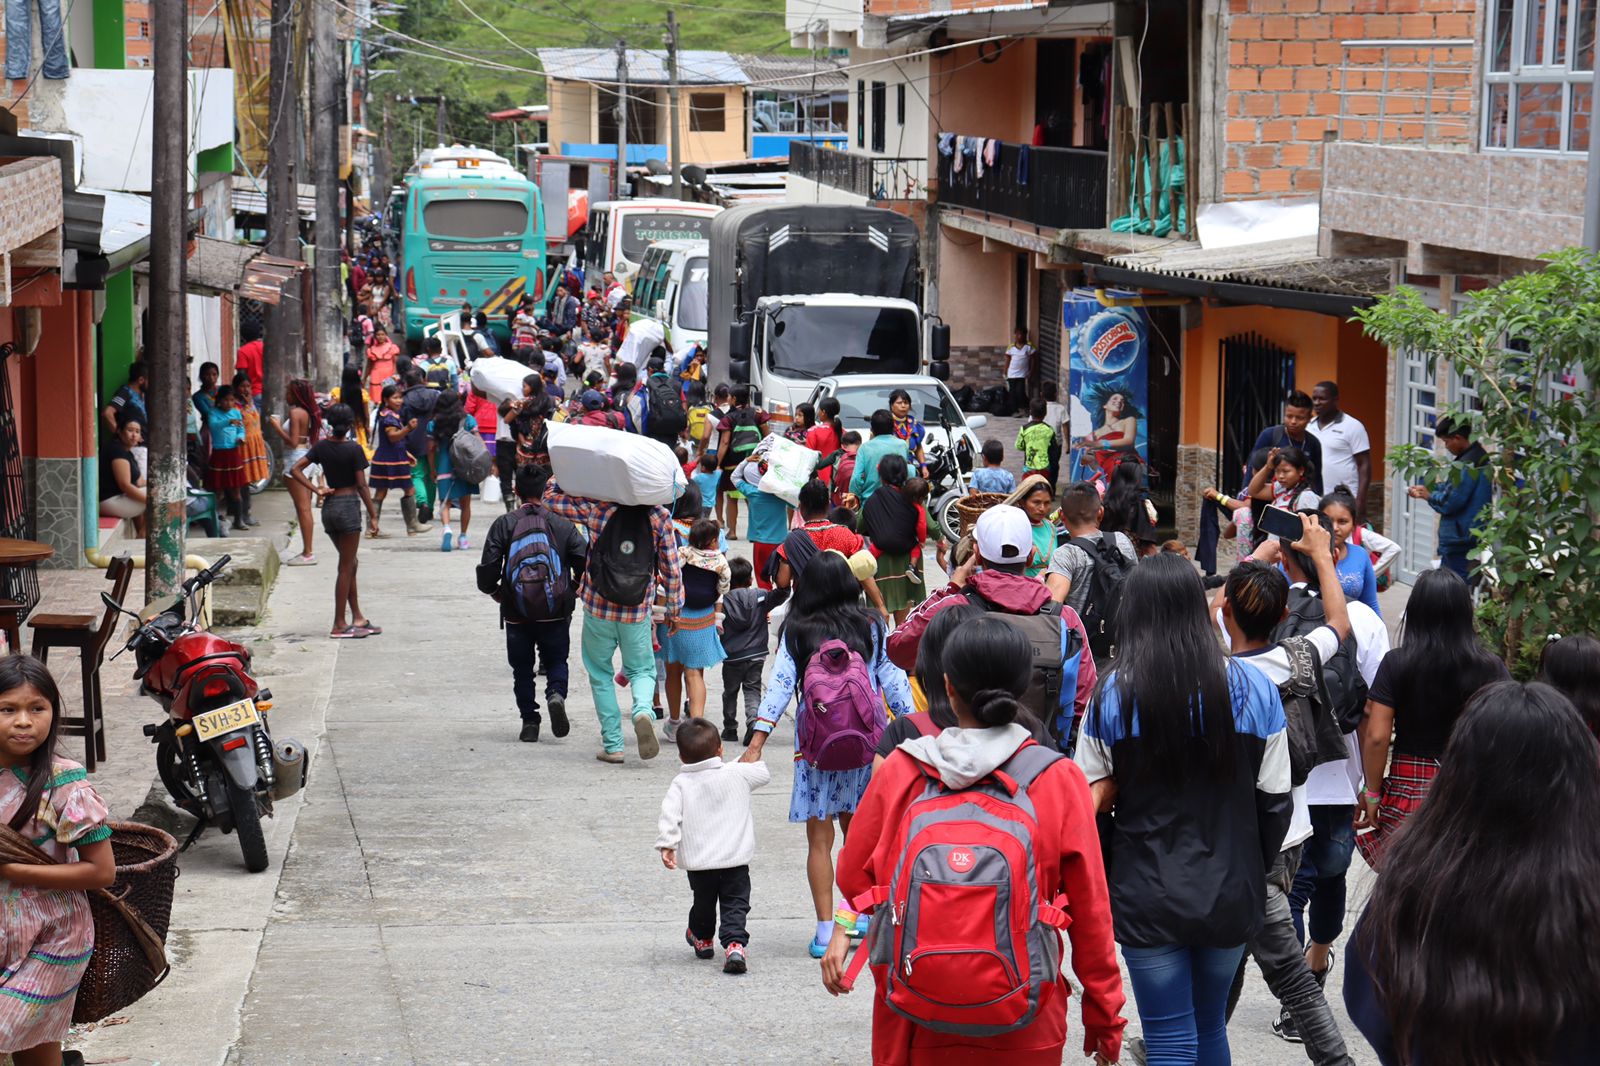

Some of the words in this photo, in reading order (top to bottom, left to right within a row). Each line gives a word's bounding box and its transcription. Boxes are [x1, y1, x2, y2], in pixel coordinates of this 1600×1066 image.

[635, 228, 703, 241] TURISMO
[1090, 321, 1132, 360] POSTOBON
[952, 852, 970, 863] DK
